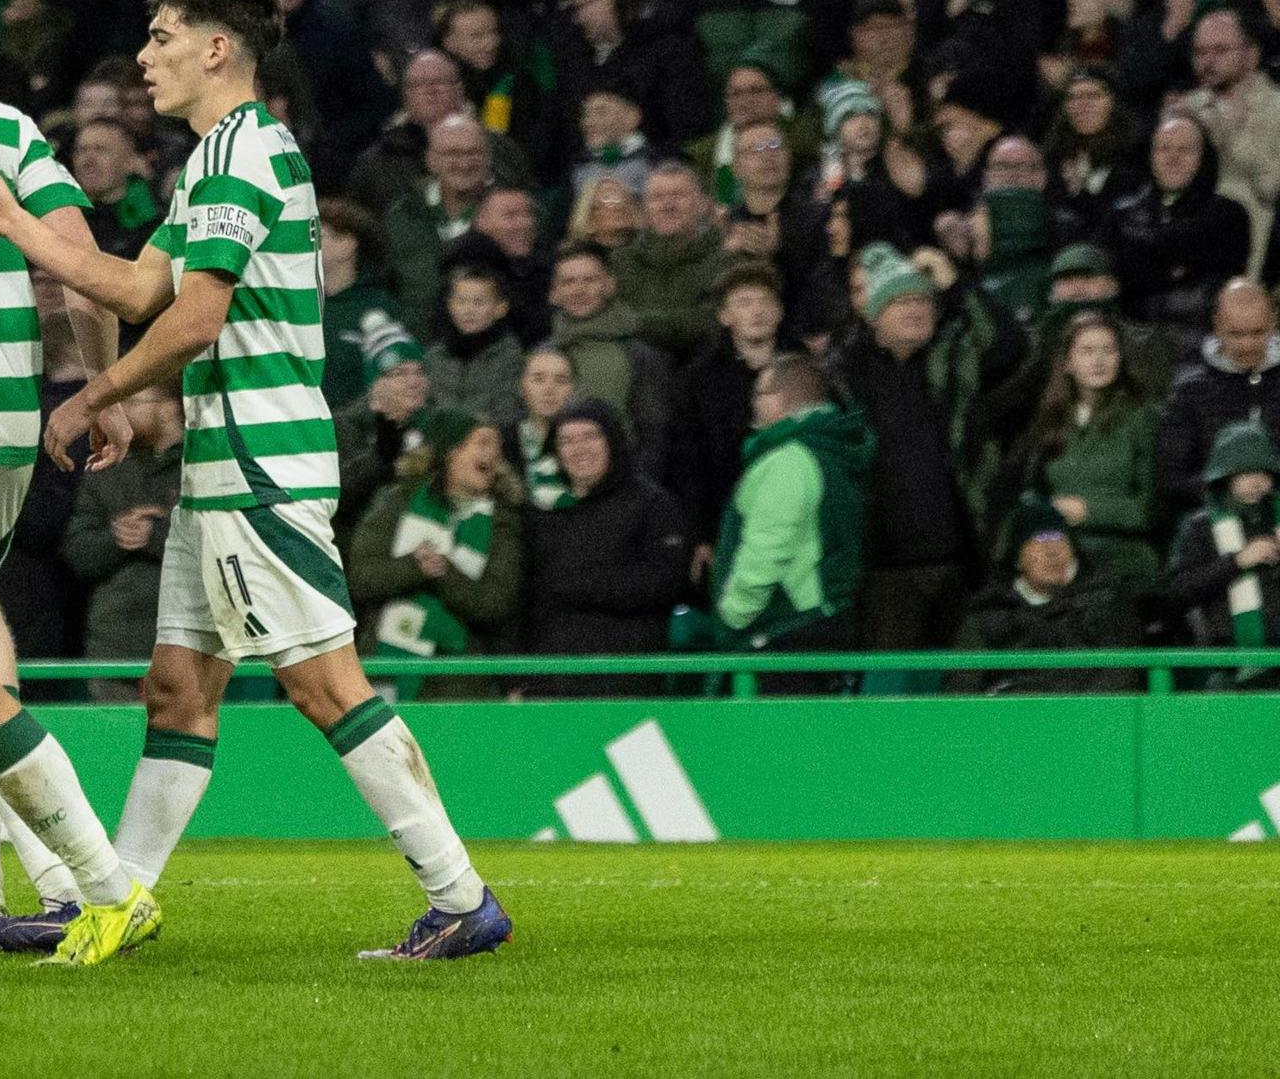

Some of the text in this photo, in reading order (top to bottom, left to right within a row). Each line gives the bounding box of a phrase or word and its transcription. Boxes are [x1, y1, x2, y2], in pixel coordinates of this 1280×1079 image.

[207, 206, 248, 226] CELTIC FC
[216, 554, 253, 610] 11
